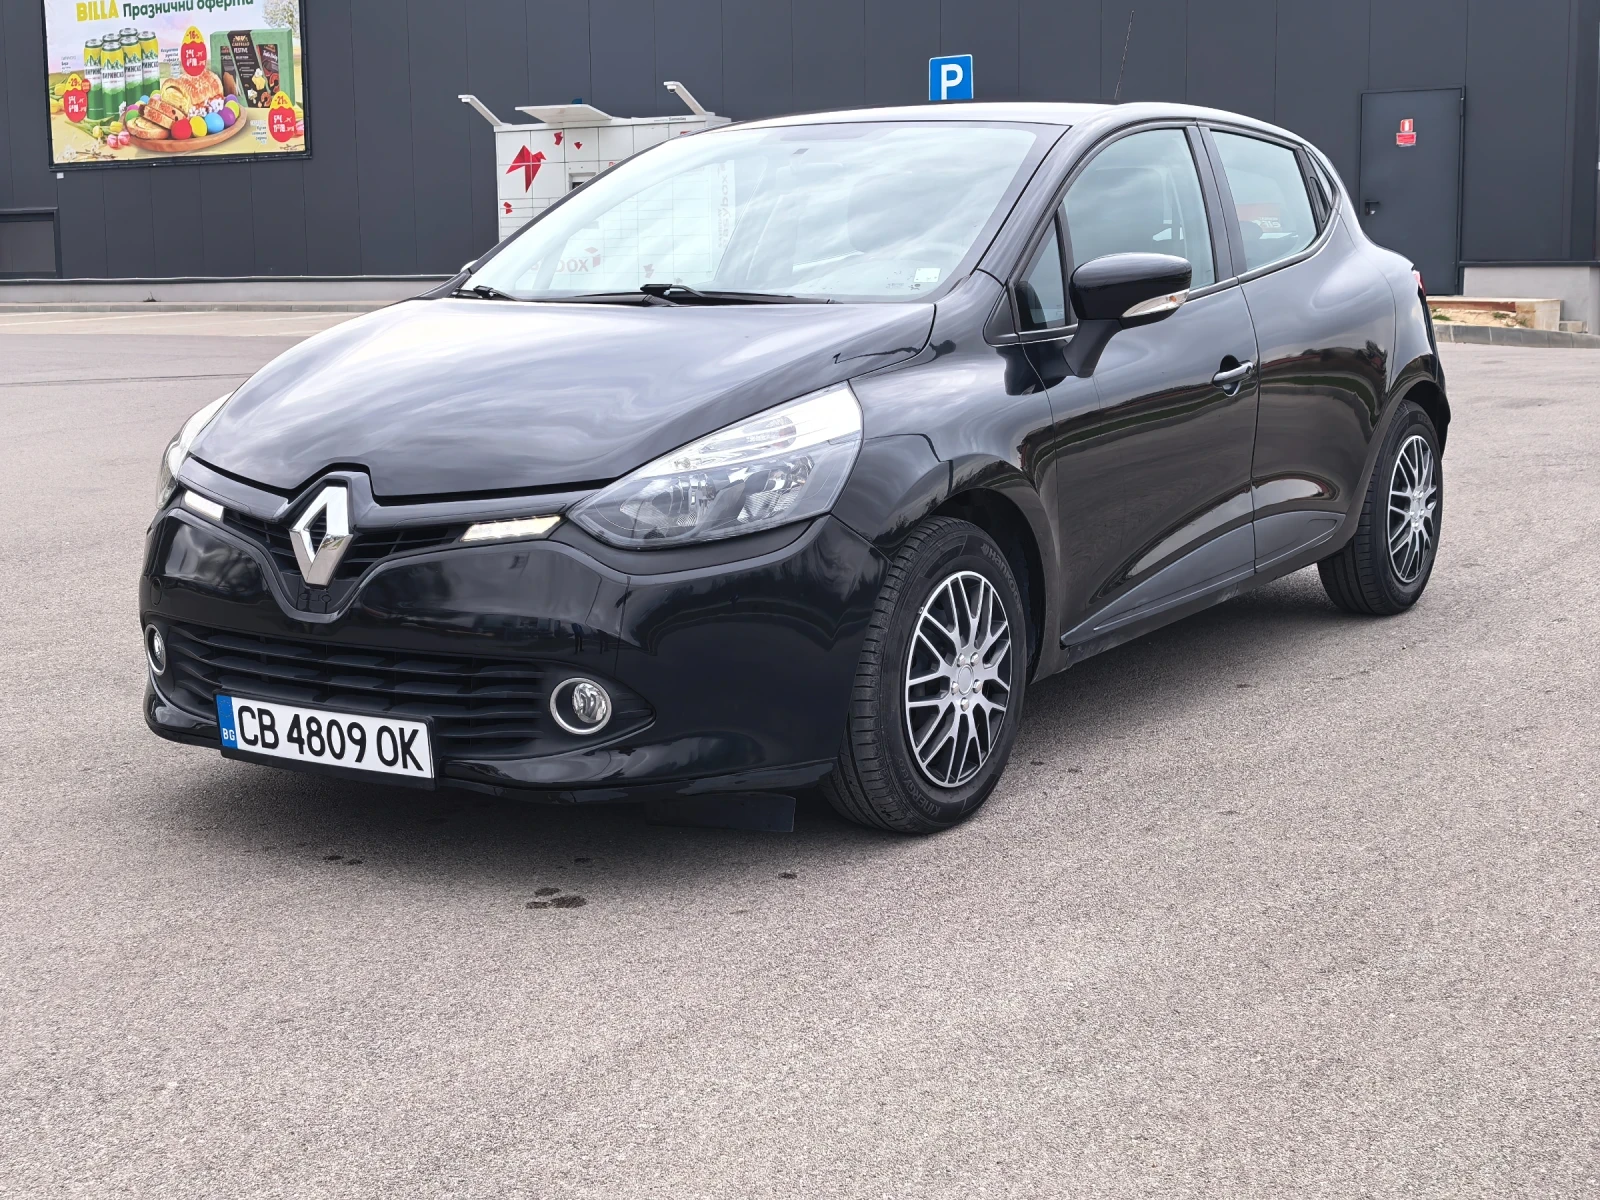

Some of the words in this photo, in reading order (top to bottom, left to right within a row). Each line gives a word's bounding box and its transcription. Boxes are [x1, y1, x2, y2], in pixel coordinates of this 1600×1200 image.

[76, 0, 119, 22] BILLA
[123, 0, 194, 20] Празнични
[941, 64, 963, 100] P
[222, 727, 236, 741] BG
[238, 705, 279, 750] CB
[287, 713, 367, 763] 4809
[376, 725, 424, 772] OK
